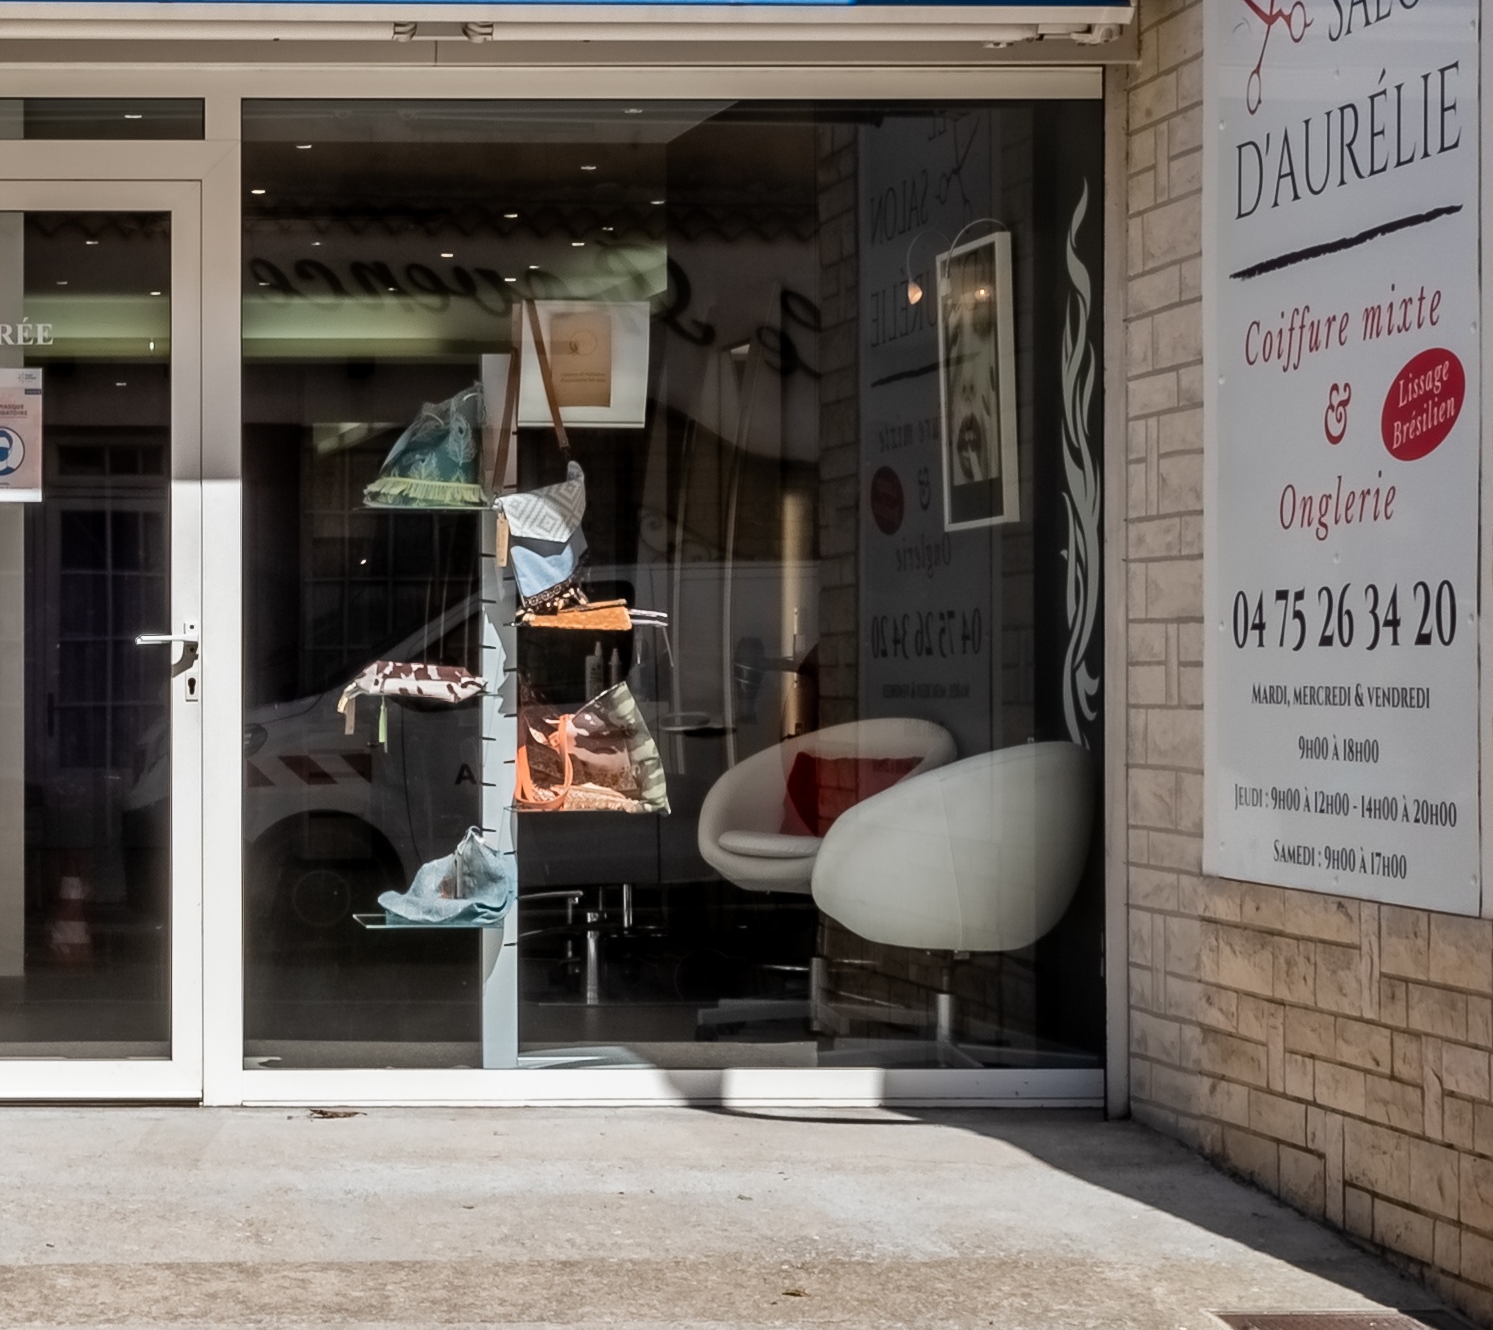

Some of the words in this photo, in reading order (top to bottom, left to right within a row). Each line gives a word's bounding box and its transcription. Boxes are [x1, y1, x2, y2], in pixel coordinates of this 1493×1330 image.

[1235, 60, 1462, 220] D'AURÉLIE
[1245, 304, 1350, 373] Coiffure
[1362, 283, 1441, 341] mixte
[1324, 382, 1351, 445] &
[1398, 360, 1450, 408] Lissage
[1392, 396, 1456, 450] Brésilien
[1279, 470, 1397, 541] Onglerie
[1232, 589, 1266, 649] 04
[1274, 585, 1307, 651] 75
[1317, 582, 1354, 648] 26
[1364, 582, 1401, 651] 34
[1412, 579, 1457, 647] 20
